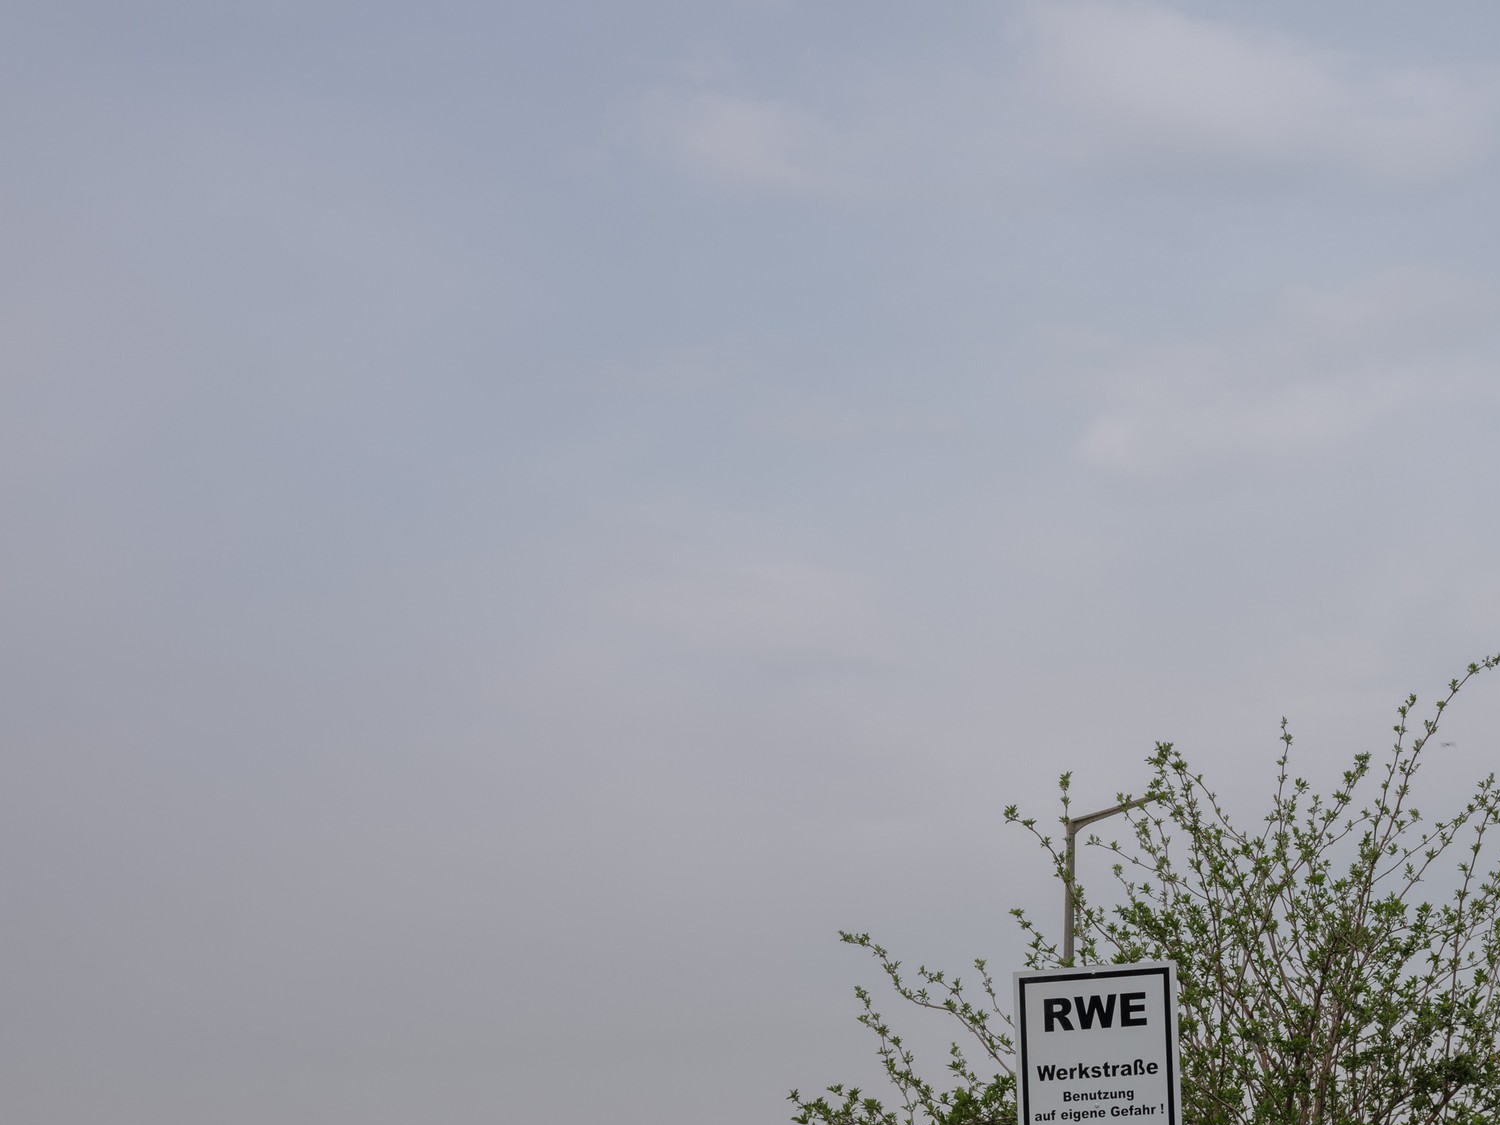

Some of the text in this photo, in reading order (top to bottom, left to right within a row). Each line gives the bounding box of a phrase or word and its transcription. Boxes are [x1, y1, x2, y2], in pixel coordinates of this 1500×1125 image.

[1043, 991, 1148, 1033] RWE
[1036, 1058, 1159, 1082] Werkstraße
[1062, 1089, 1135, 1102] Benutzung
[1034, 1109, 1056, 1122] auf
[1060, 1108, 1106, 1122] eigene
[1110, 1104, 1156, 1117] Gefahr
